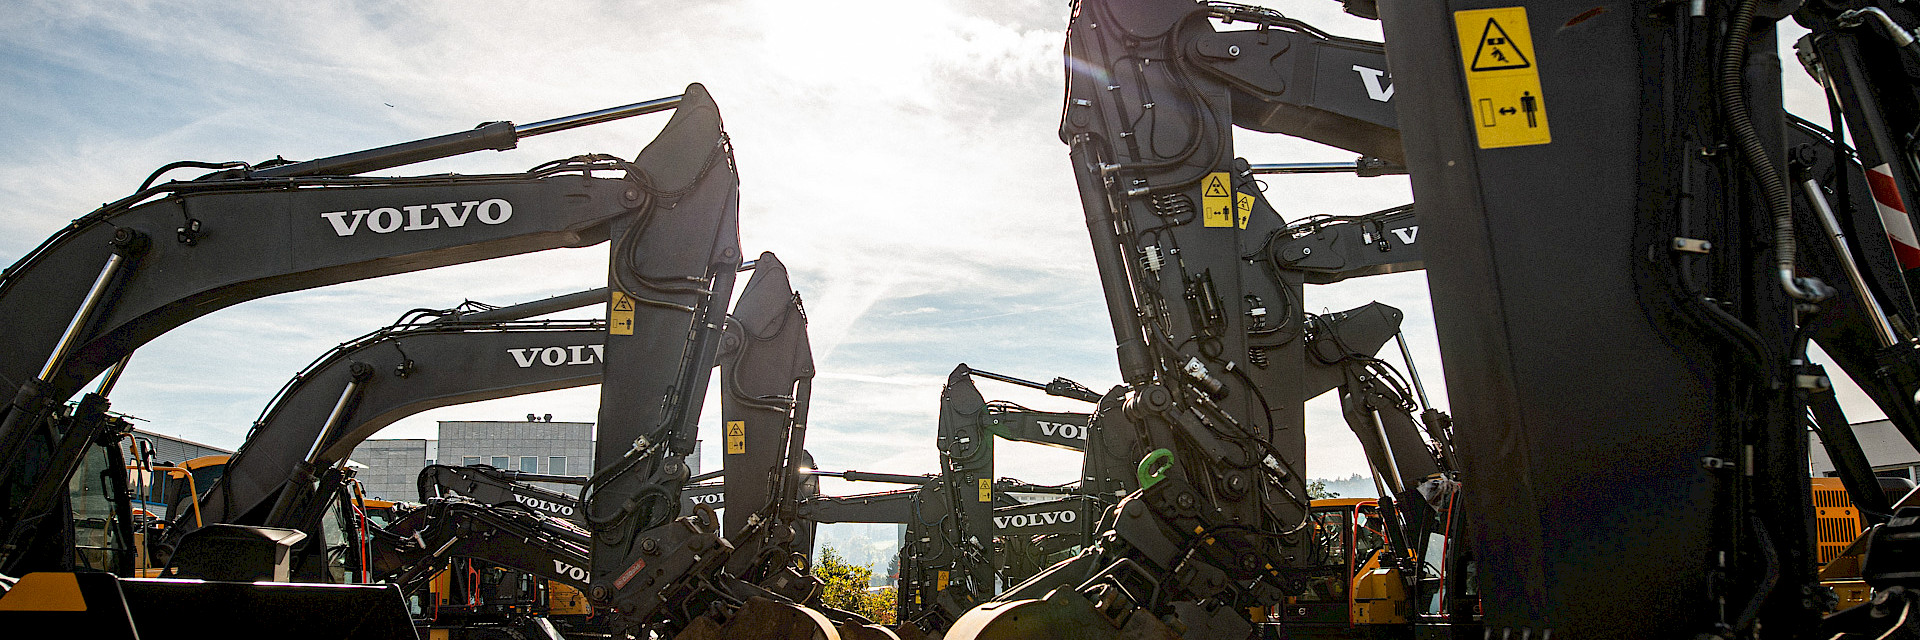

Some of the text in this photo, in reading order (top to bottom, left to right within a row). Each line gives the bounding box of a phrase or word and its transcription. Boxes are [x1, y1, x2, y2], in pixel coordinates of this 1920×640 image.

[320, 198, 513, 237] VOLVO
[513, 493, 574, 516] VOLVO
[993, 510, 1076, 529] VOLVO
